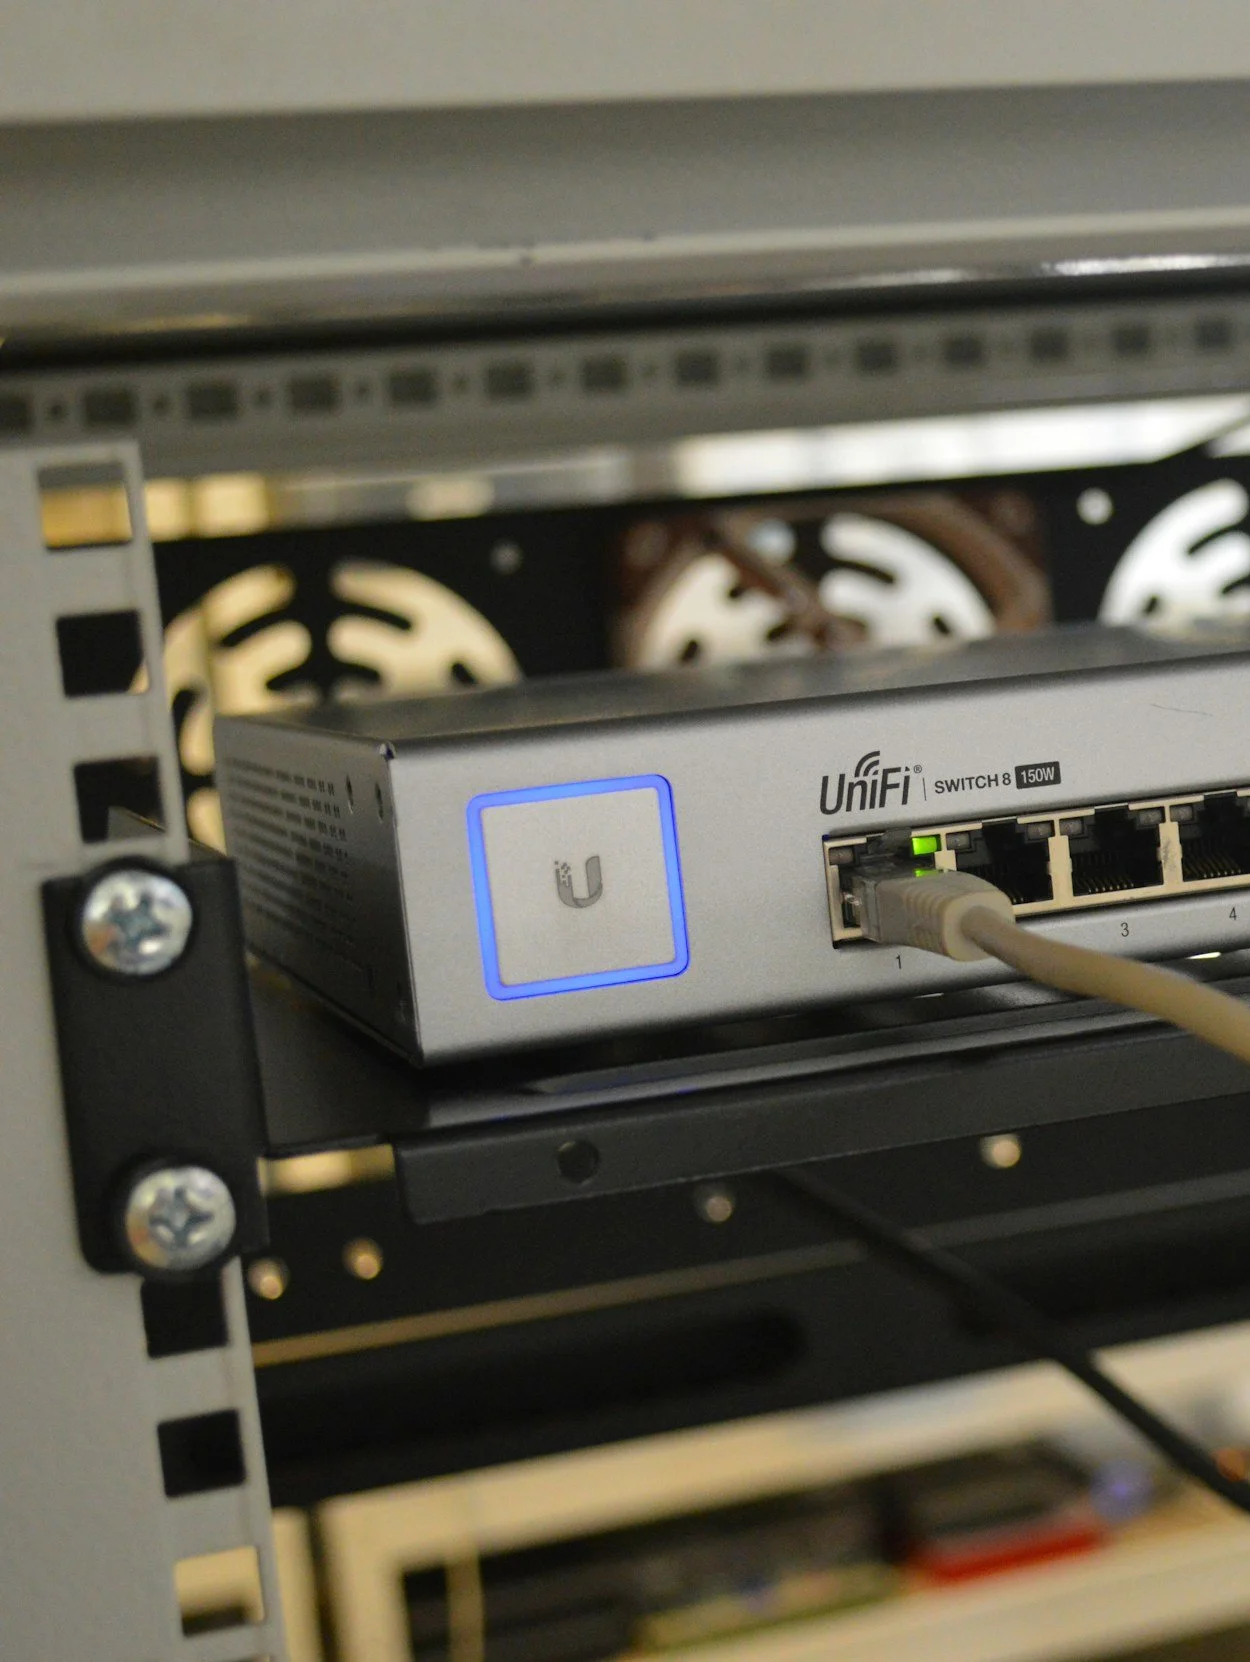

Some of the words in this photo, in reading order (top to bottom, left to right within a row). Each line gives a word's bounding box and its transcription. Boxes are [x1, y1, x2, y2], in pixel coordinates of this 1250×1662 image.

[934, 774, 999, 794] SWITCH
[1002, 772, 1012, 786] 8
[1020, 766, 1056, 785] 150W
[1228, 907, 1238, 922] 4
[1120, 922, 1130, 937] 3
[895, 955, 903, 970] 1
